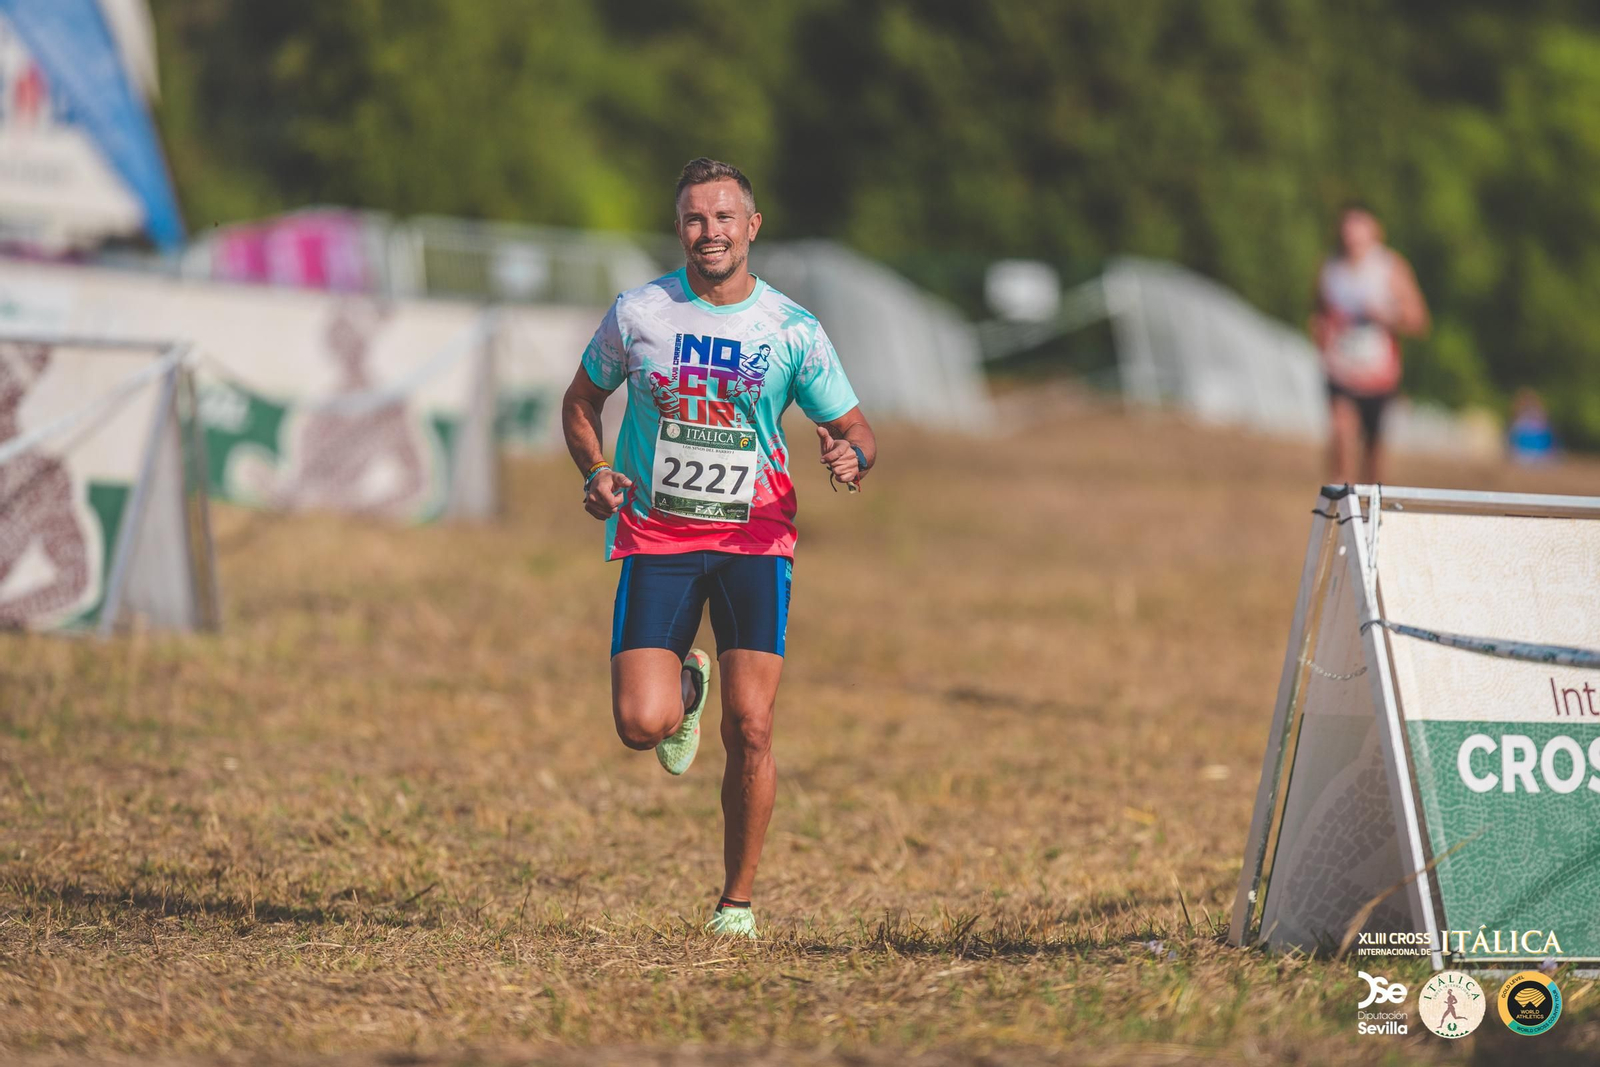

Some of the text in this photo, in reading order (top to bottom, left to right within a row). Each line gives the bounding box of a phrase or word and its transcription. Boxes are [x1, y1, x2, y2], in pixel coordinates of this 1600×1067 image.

[673, 333, 682, 366] CARRERA
[681, 334, 741, 369] NO
[679, 365, 737, 401] CT
[686, 428, 734, 444] ITÁLICA
[662, 456, 749, 496] 2227
